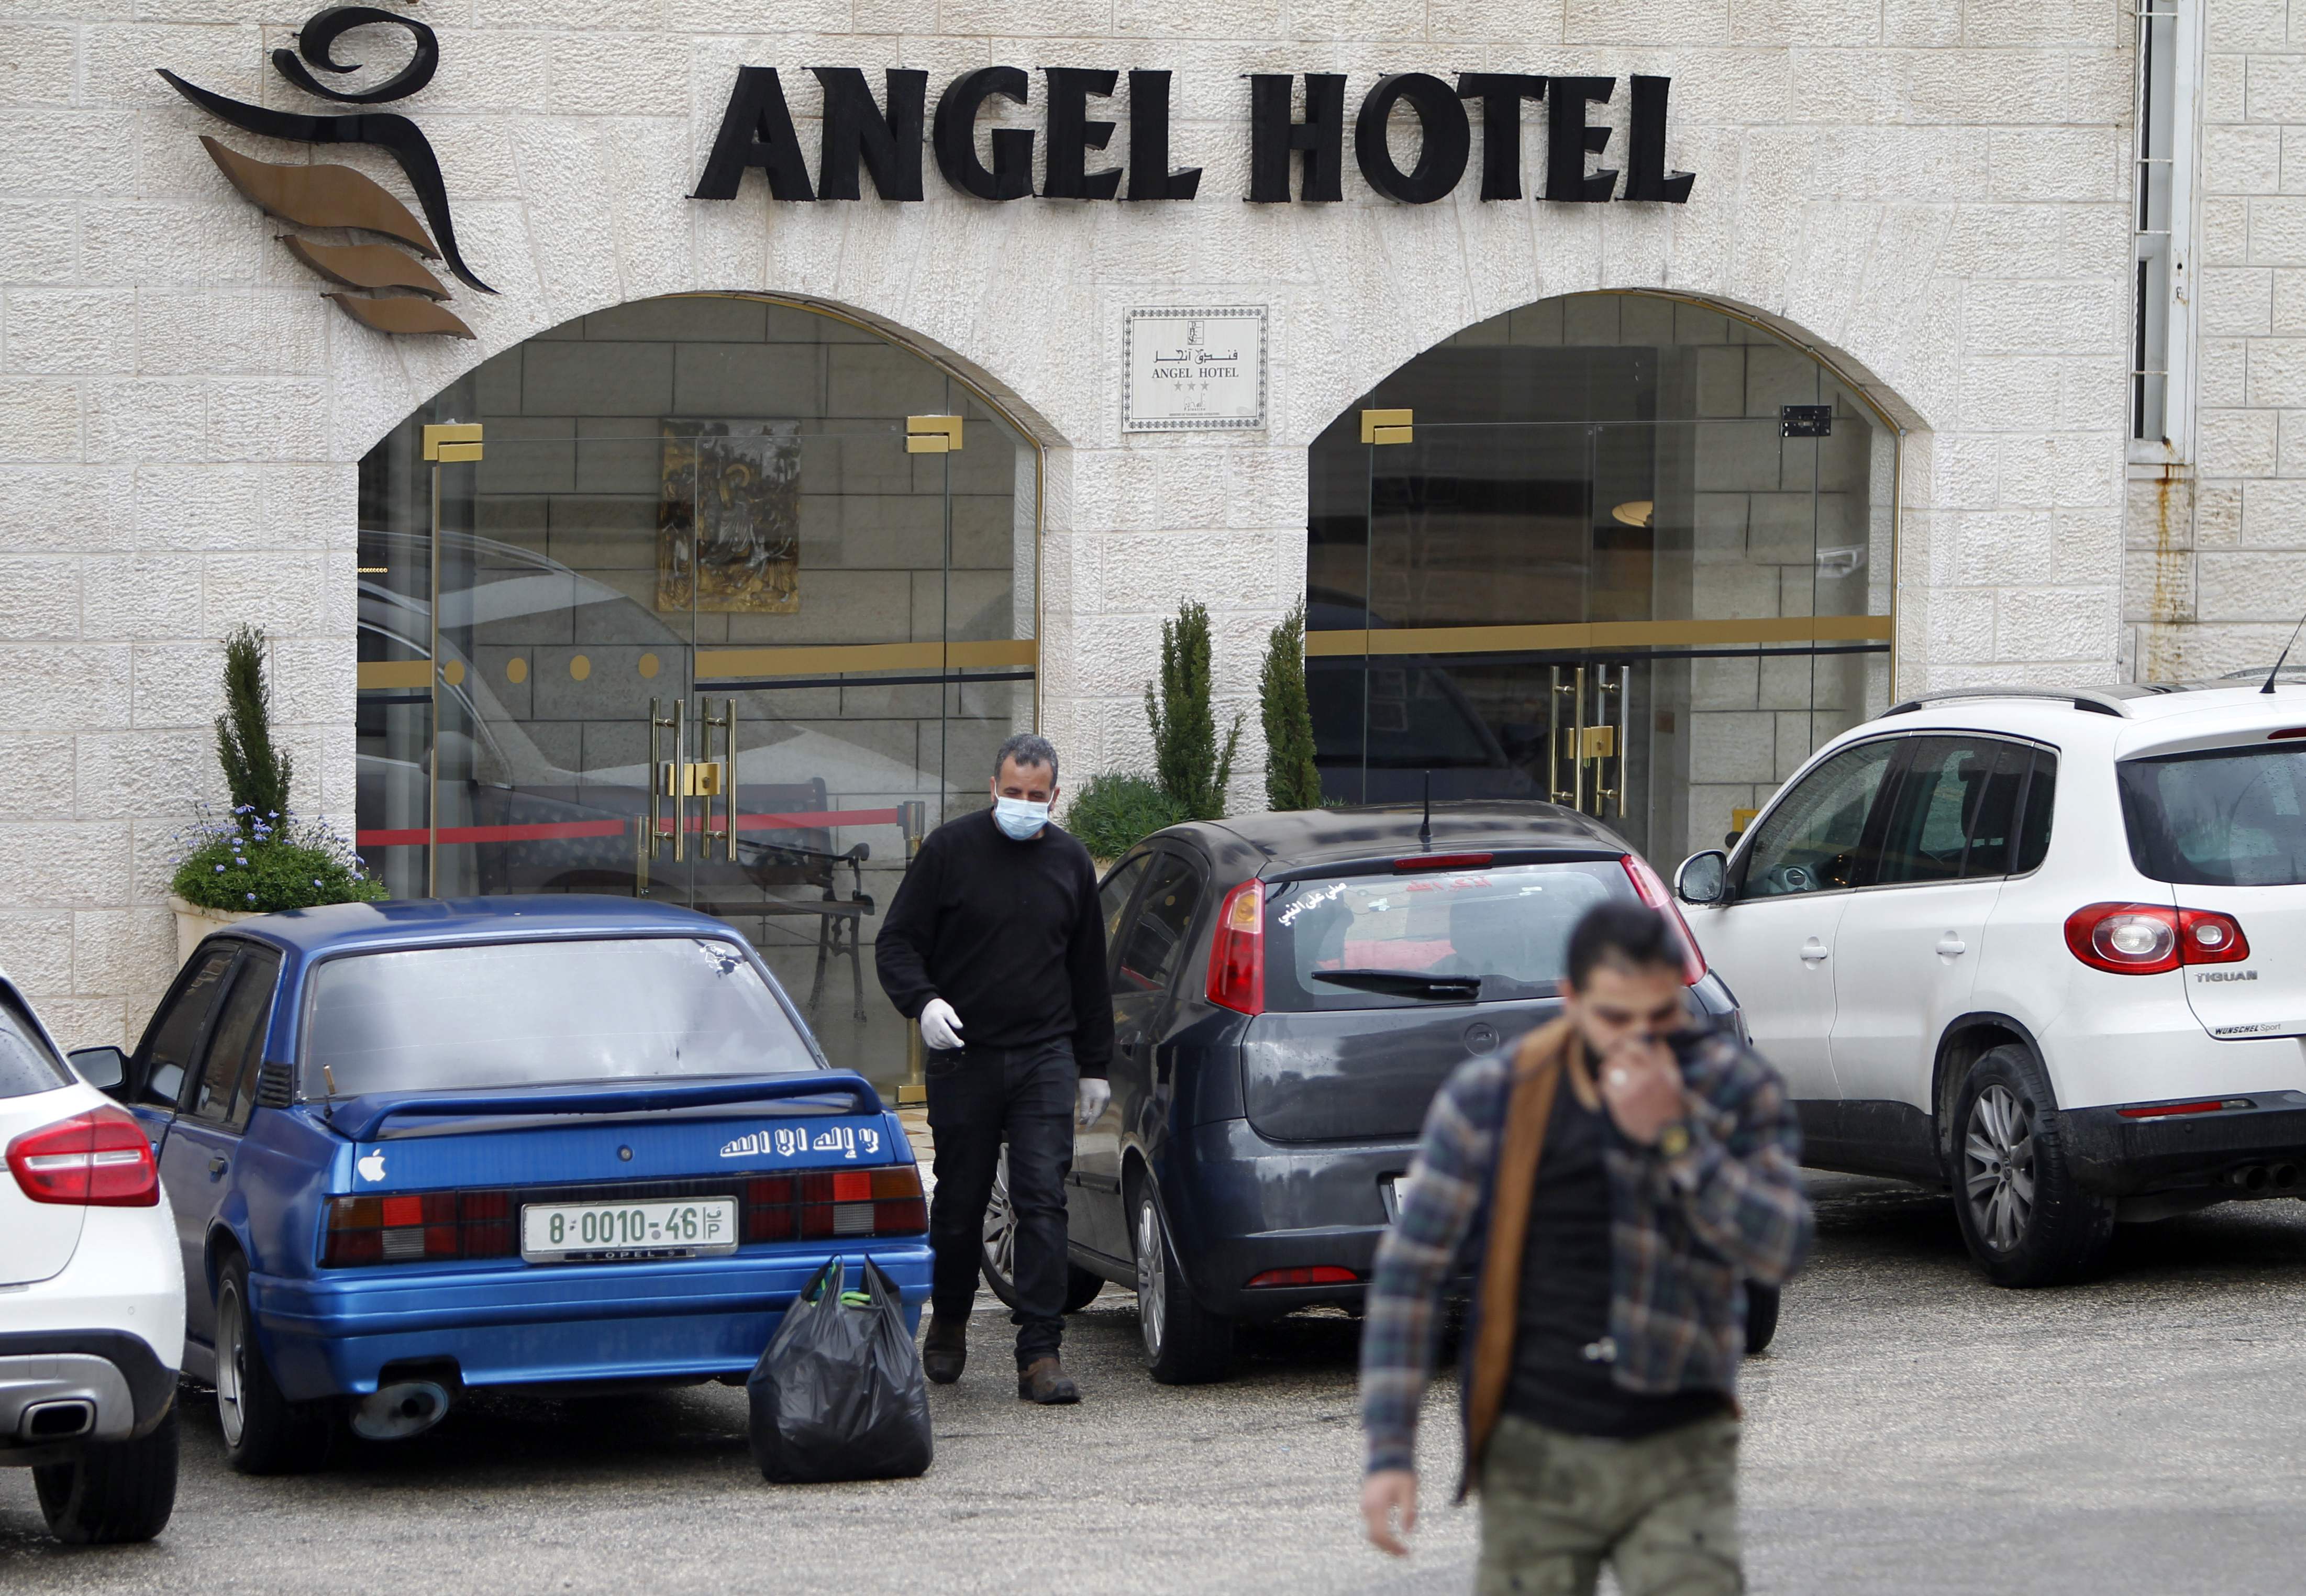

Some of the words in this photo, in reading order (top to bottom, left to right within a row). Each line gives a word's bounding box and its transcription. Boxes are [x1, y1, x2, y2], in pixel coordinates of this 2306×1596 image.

[691, 66, 1203, 201] ANGEL
[1249, 72, 1696, 204] HOTEL
[1194, 349, 1238, 365] فندق
[1152, 368, 1192, 378] ANGEL
[1199, 367, 1239, 378] HOTEL
[1325, 883, 1347, 900] صلي
[1278, 900, 1306, 926] النبي
[2194, 970, 2258, 982] TIGUAN
[720, 1130, 770, 1157] الله
[813, 1127, 857, 1158] إله
[708, 1223, 719, 1239] P
[605, 1250, 655, 1259] OPEL
